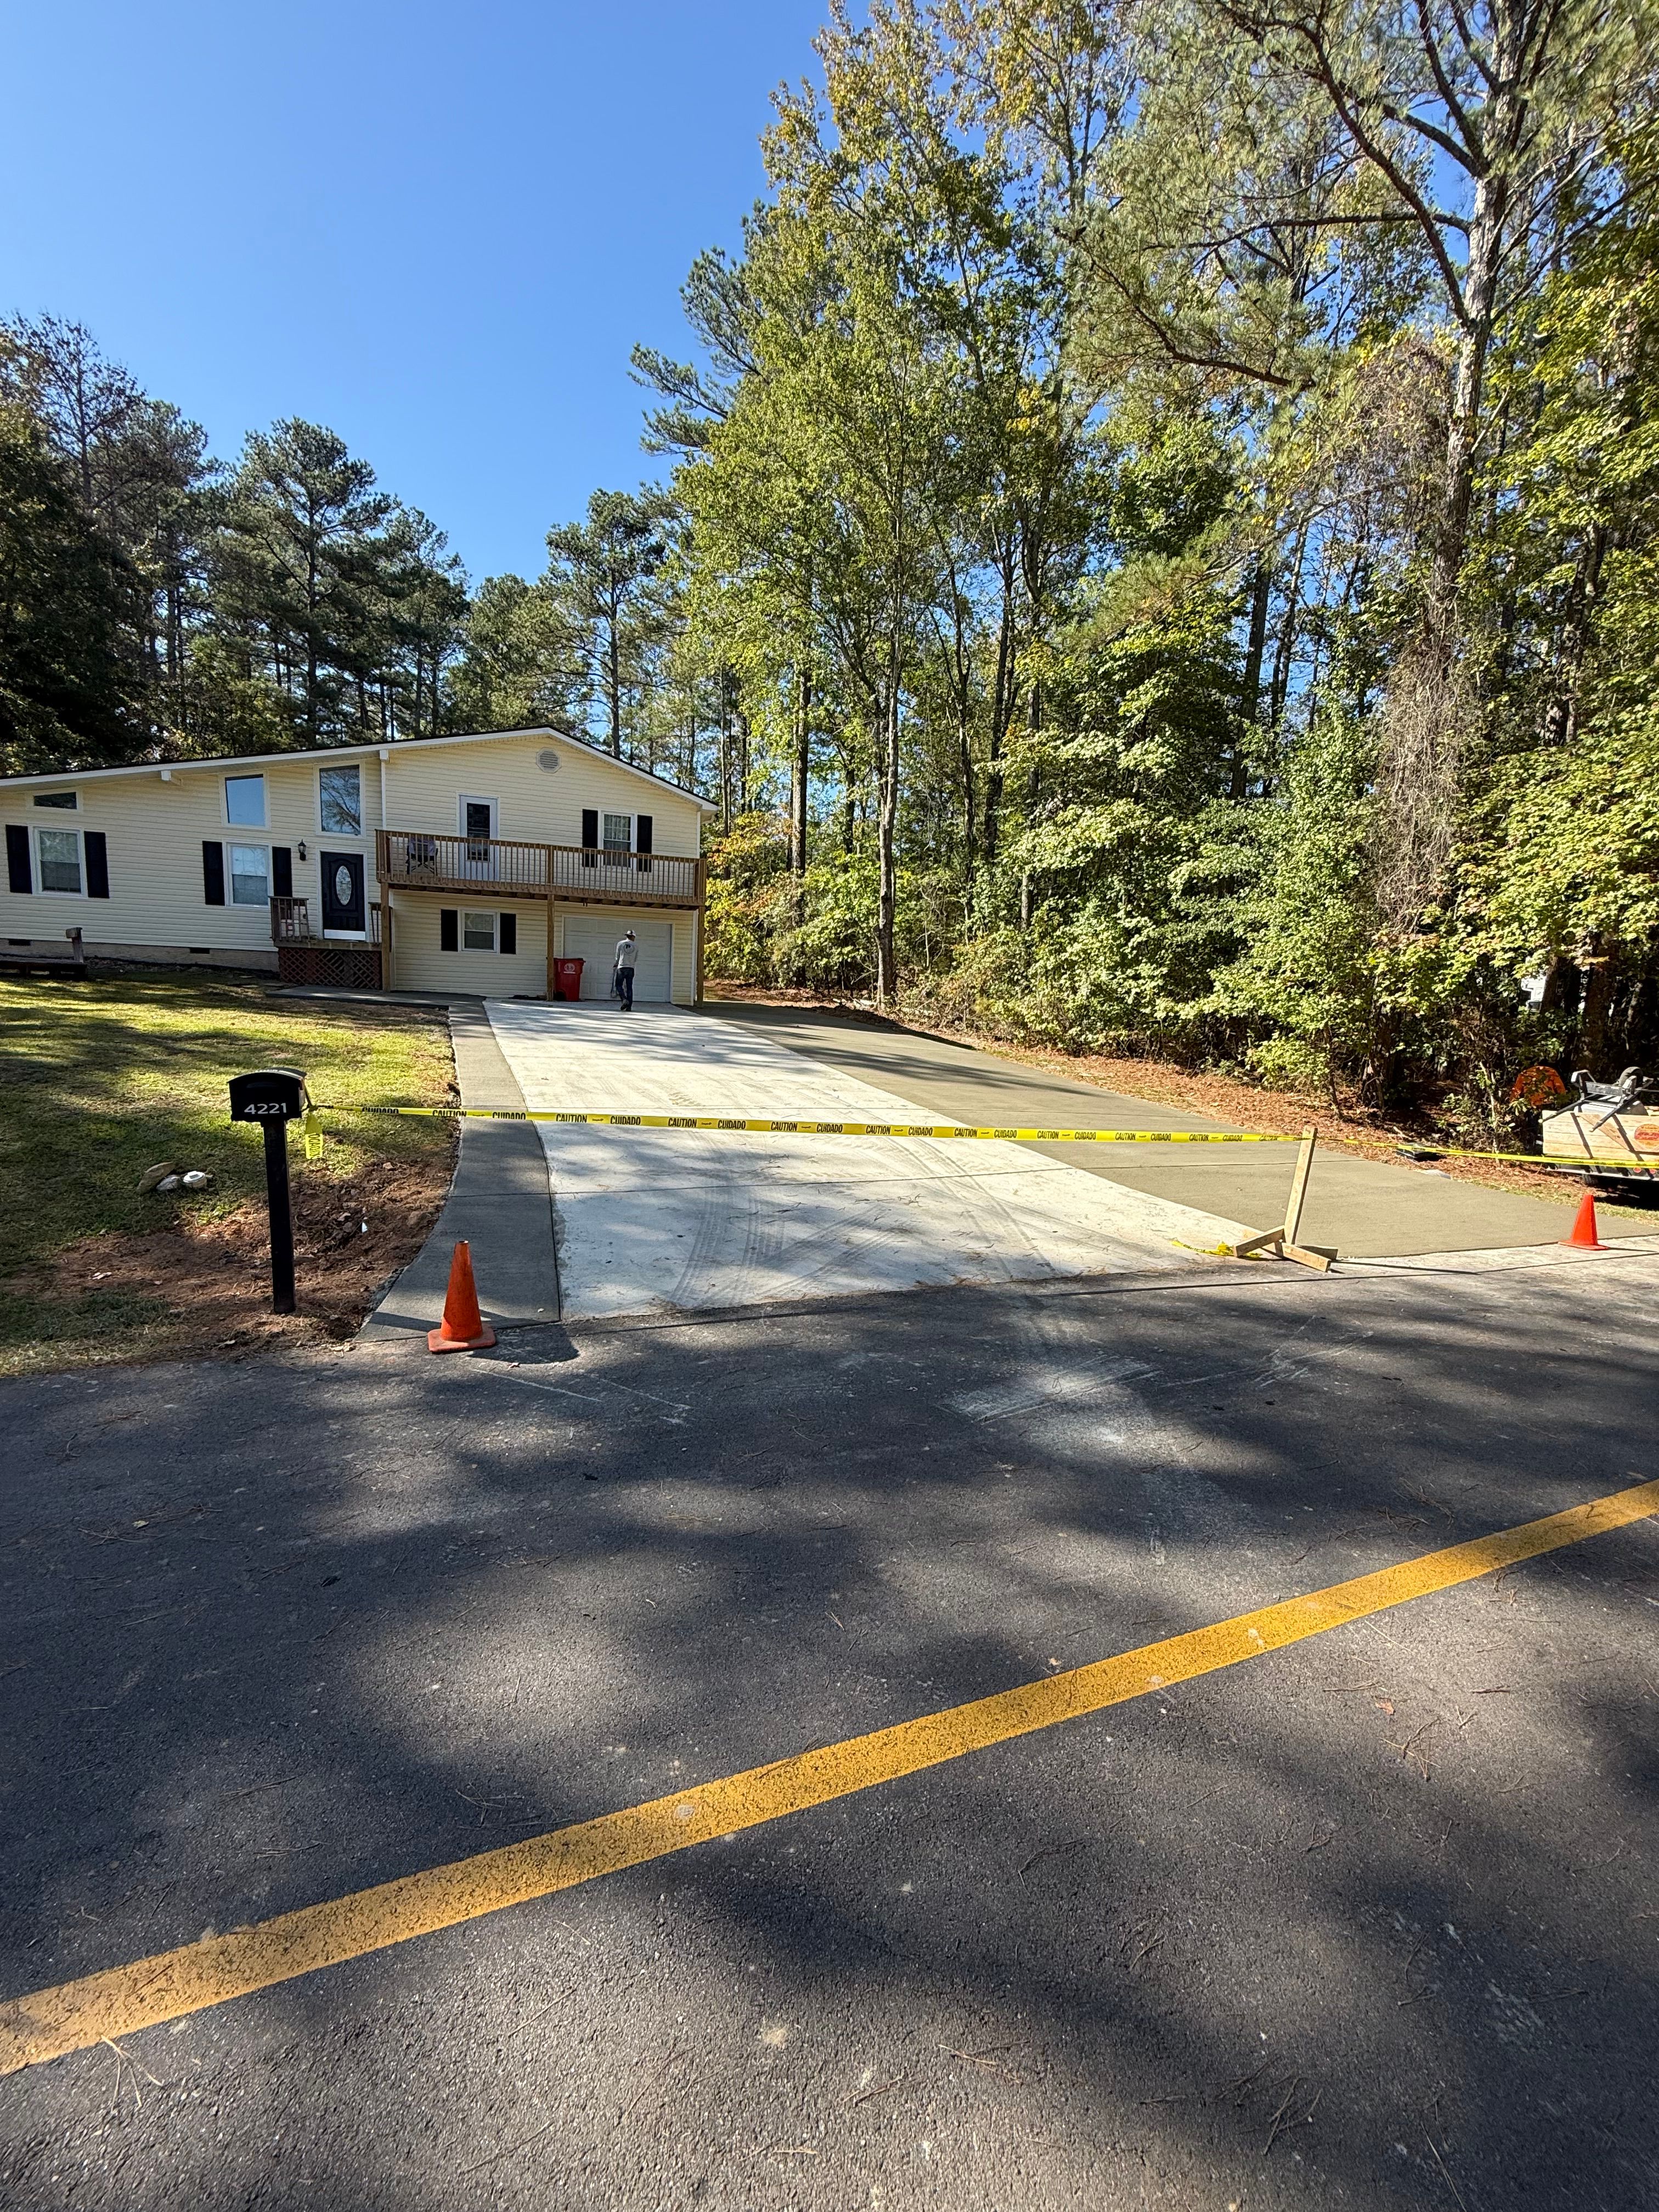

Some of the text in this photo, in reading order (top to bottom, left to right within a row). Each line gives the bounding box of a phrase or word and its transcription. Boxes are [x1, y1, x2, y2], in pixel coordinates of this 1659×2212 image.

[244, 1102, 287, 1115] 4221
[556, 1114, 588, 1122] CAUTION
[610, 1116, 641, 1125] CUIDADO
[668, 1118, 697, 1127] CAUTION
[718, 1120, 746, 1130] CUIDADO
[771, 1122, 798, 1131] CAUTION
[816, 1124, 843, 1133] CUIDADO
[866, 1125, 891, 1135] CAUTION
[908, 1127, 933, 1136] CUIDADO
[954, 1128, 978, 1137] CAUTION
[994, 1130, 1017, 1138] CUIDADO
[1037, 1131, 1059, 1139] CAUTION
[1075, 1132, 1096, 1140] CUIDADO
[1115, 1132, 1136, 1141] CAUTION
